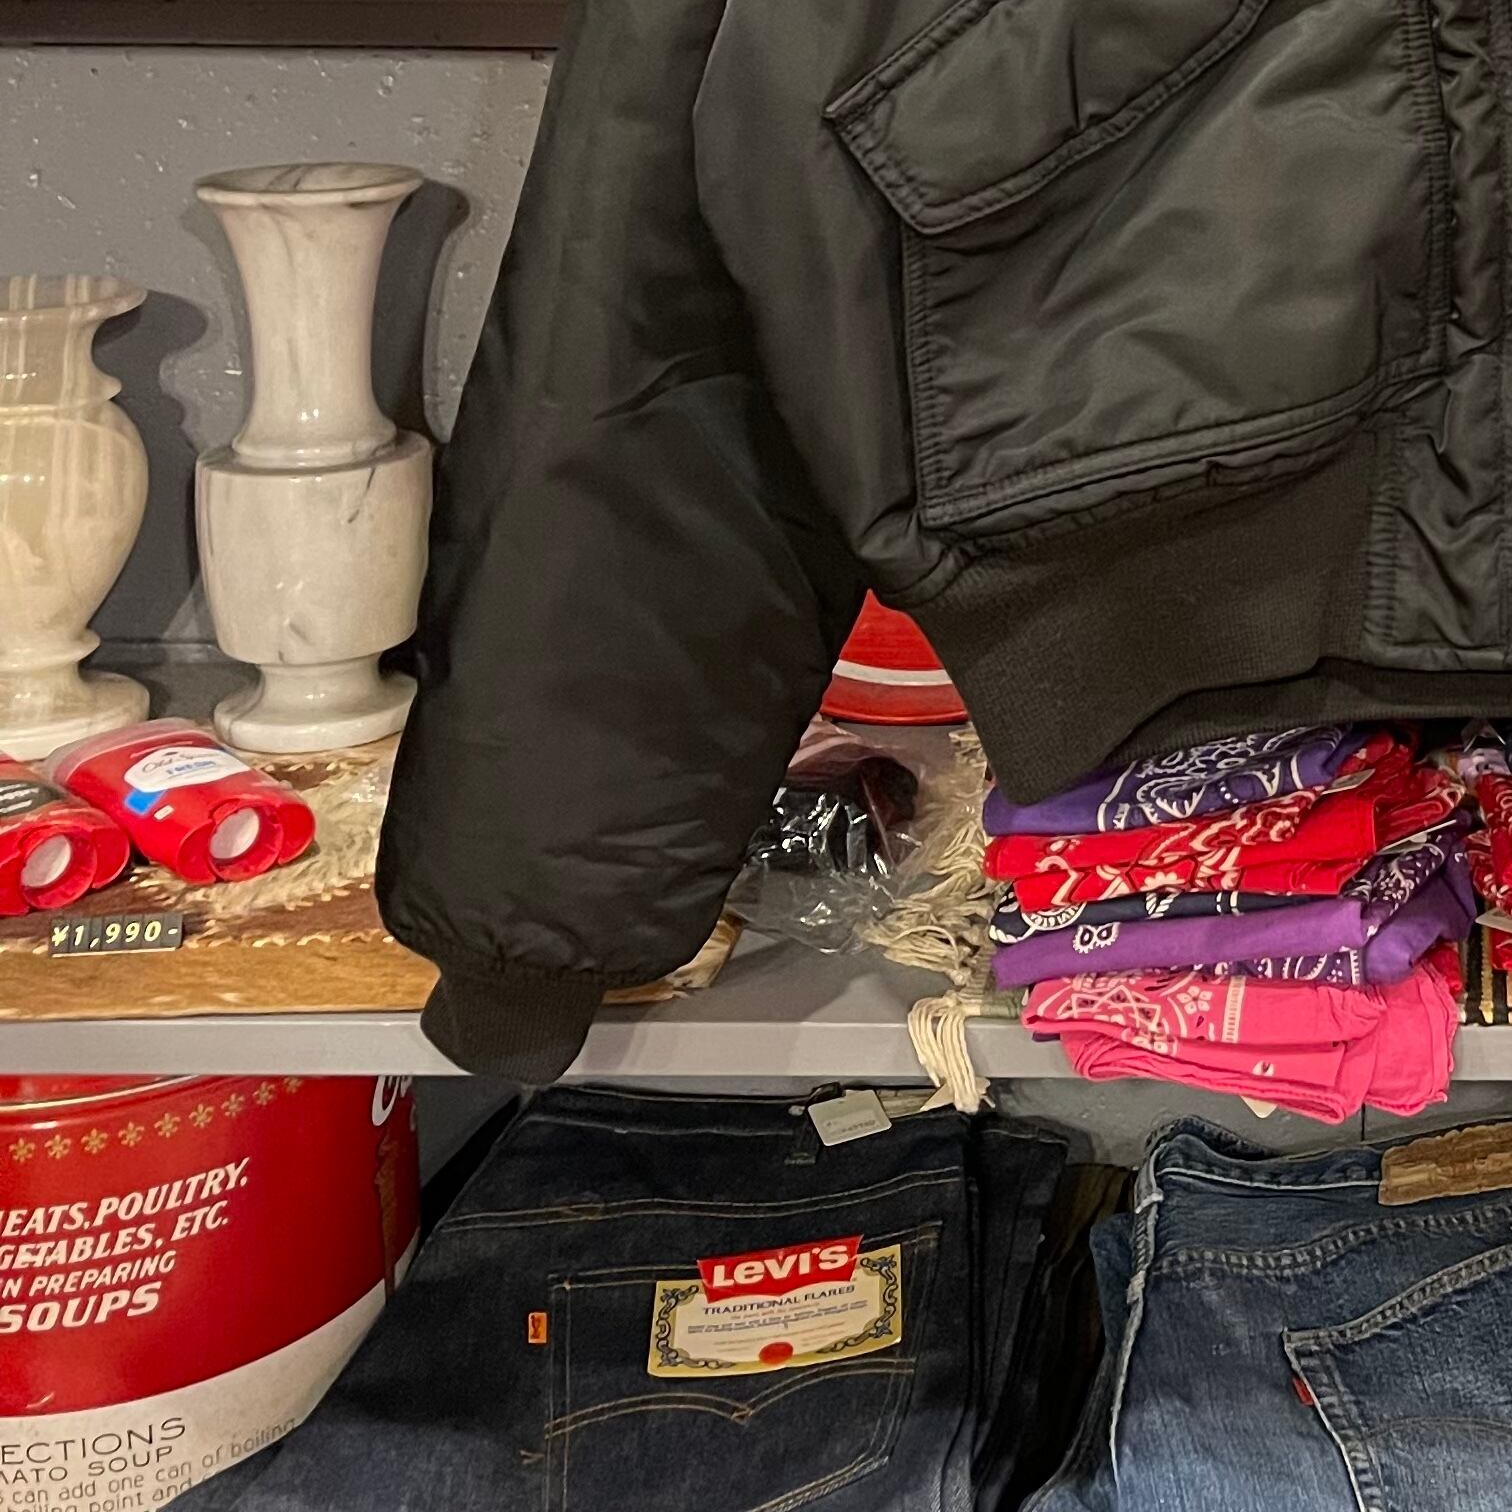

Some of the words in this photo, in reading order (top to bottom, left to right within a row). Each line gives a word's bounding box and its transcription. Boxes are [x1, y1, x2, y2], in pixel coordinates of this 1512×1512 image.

[0, 1202, 90, 1237] EATS,
[170, 1200, 229, 1242] ETC.
[28, 1250, 177, 1297] PREPARING
[0, 1281, 162, 1334] SOUPS
[703, 1292, 800, 1315] TRADITIONAL
[803, 1284, 855, 1301] FLARES
[1, 1417, 186, 1466] ECTIONS
[87, 1445, 173, 1477] SOUP
[12, 1488, 49, 1504] can
[58, 1480, 97, 1501] add
[107, 1474, 144, 1494] one
[155, 1461, 192, 1482] can
[201, 1443, 224, 1469] of
